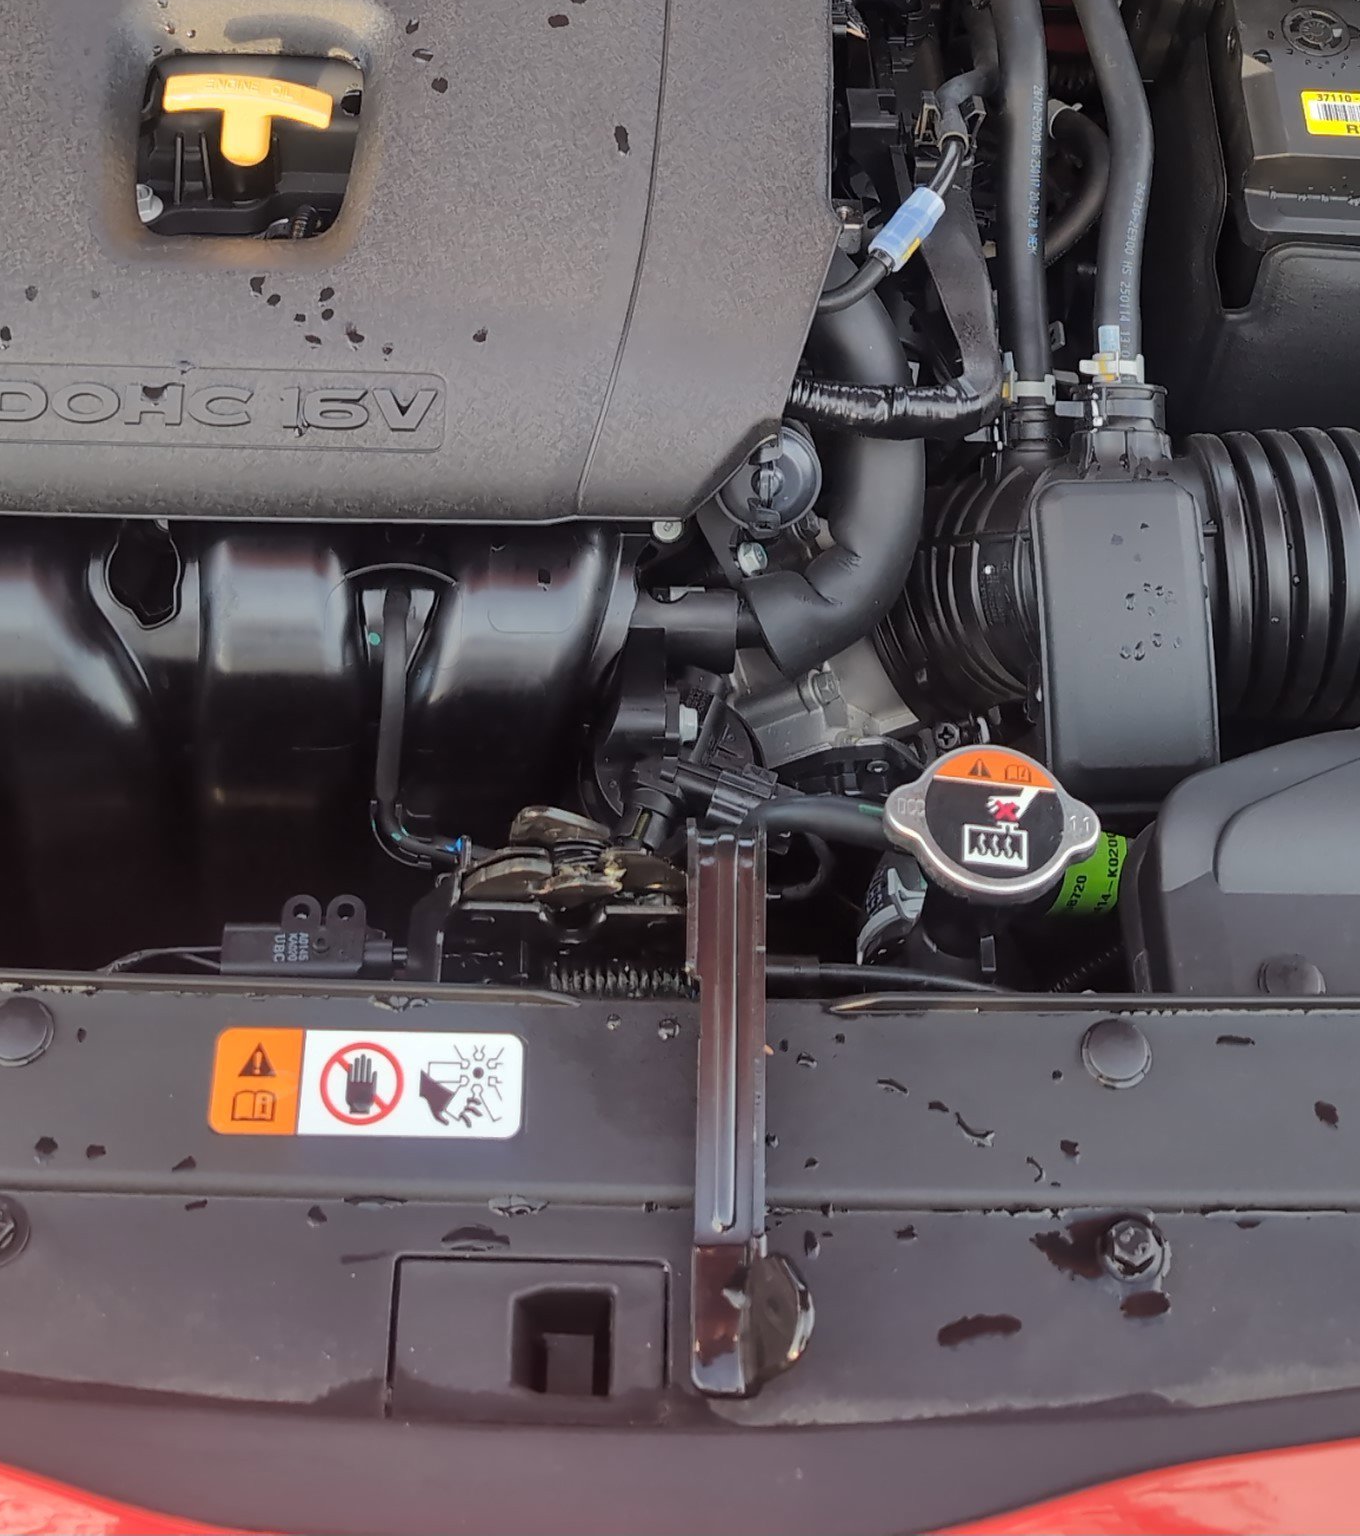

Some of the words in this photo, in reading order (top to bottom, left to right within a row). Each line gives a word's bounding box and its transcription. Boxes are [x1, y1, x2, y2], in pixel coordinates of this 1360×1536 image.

[206, 78, 260, 92] ENGINE
[270, 84, 294, 100] OIL
[1119, 280, 1132, 323] 250114
[282, 385, 438, 432] 16V
[274, 933, 286, 963] UBC
